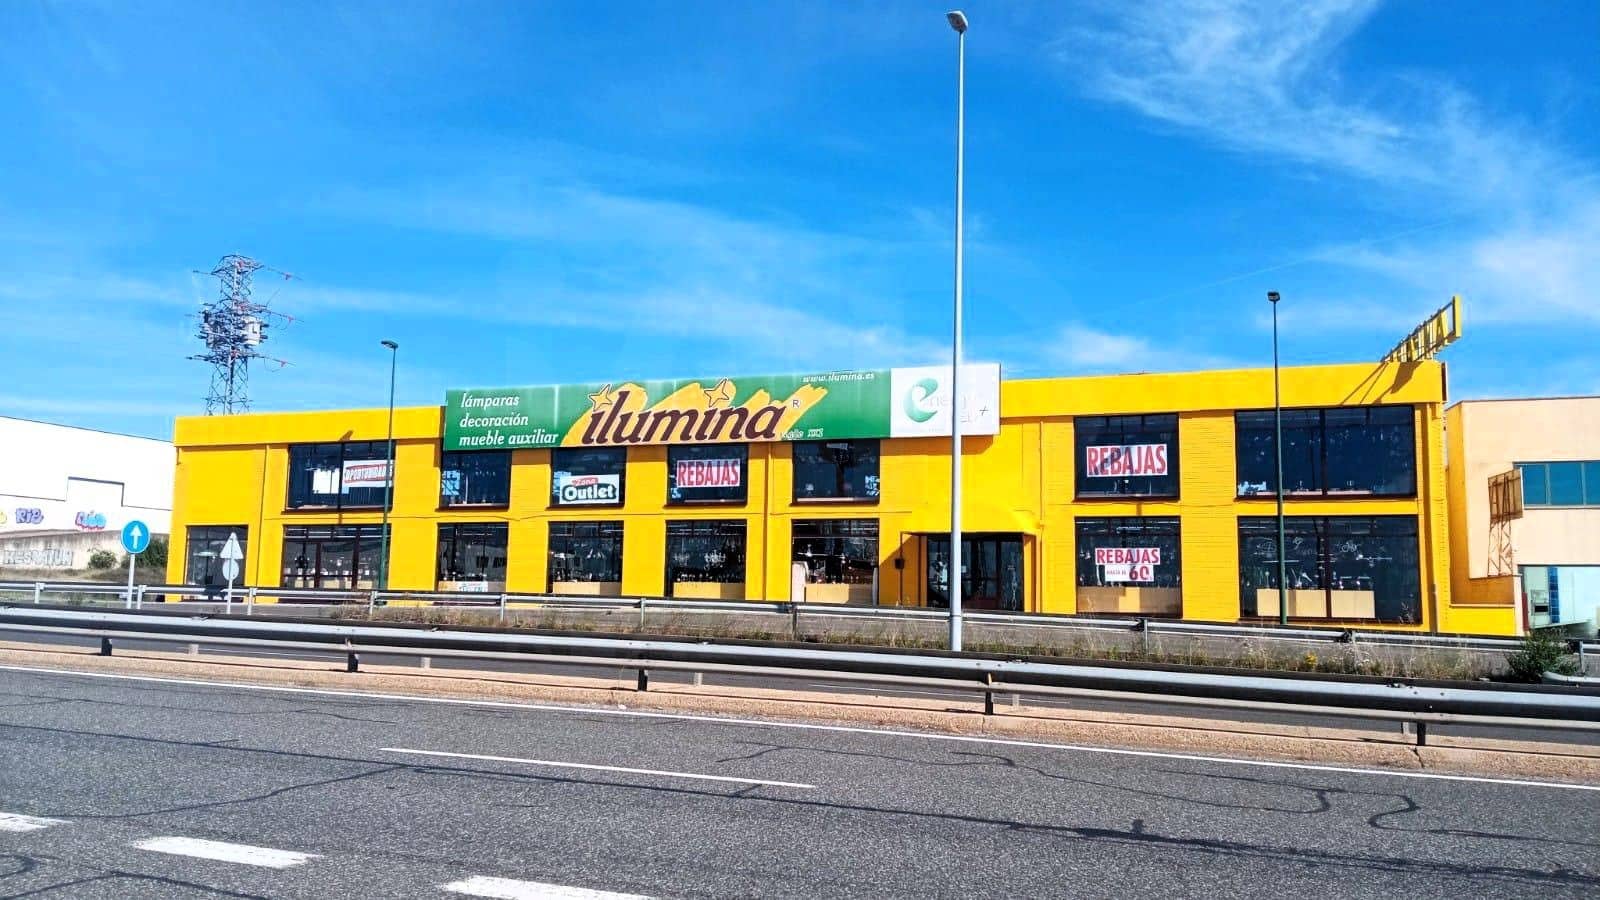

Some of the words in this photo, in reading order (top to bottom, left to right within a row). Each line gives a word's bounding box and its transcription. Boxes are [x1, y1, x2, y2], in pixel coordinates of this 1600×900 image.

[803, 370, 875, 383] www.ilumina.es
[461, 392, 520, 409] lámparas
[459, 414, 529, 428] decoración
[581, 384, 787, 446] ilumina
[459, 432, 504, 446] mueble
[508, 428, 559, 445] auxiliar
[1087, 445, 1166, 475] REBAJAS
[677, 460, 739, 487] REBAJAS
[564, 484, 614, 500] Outlet
[1096, 549, 1160, 564] REBAJAS
